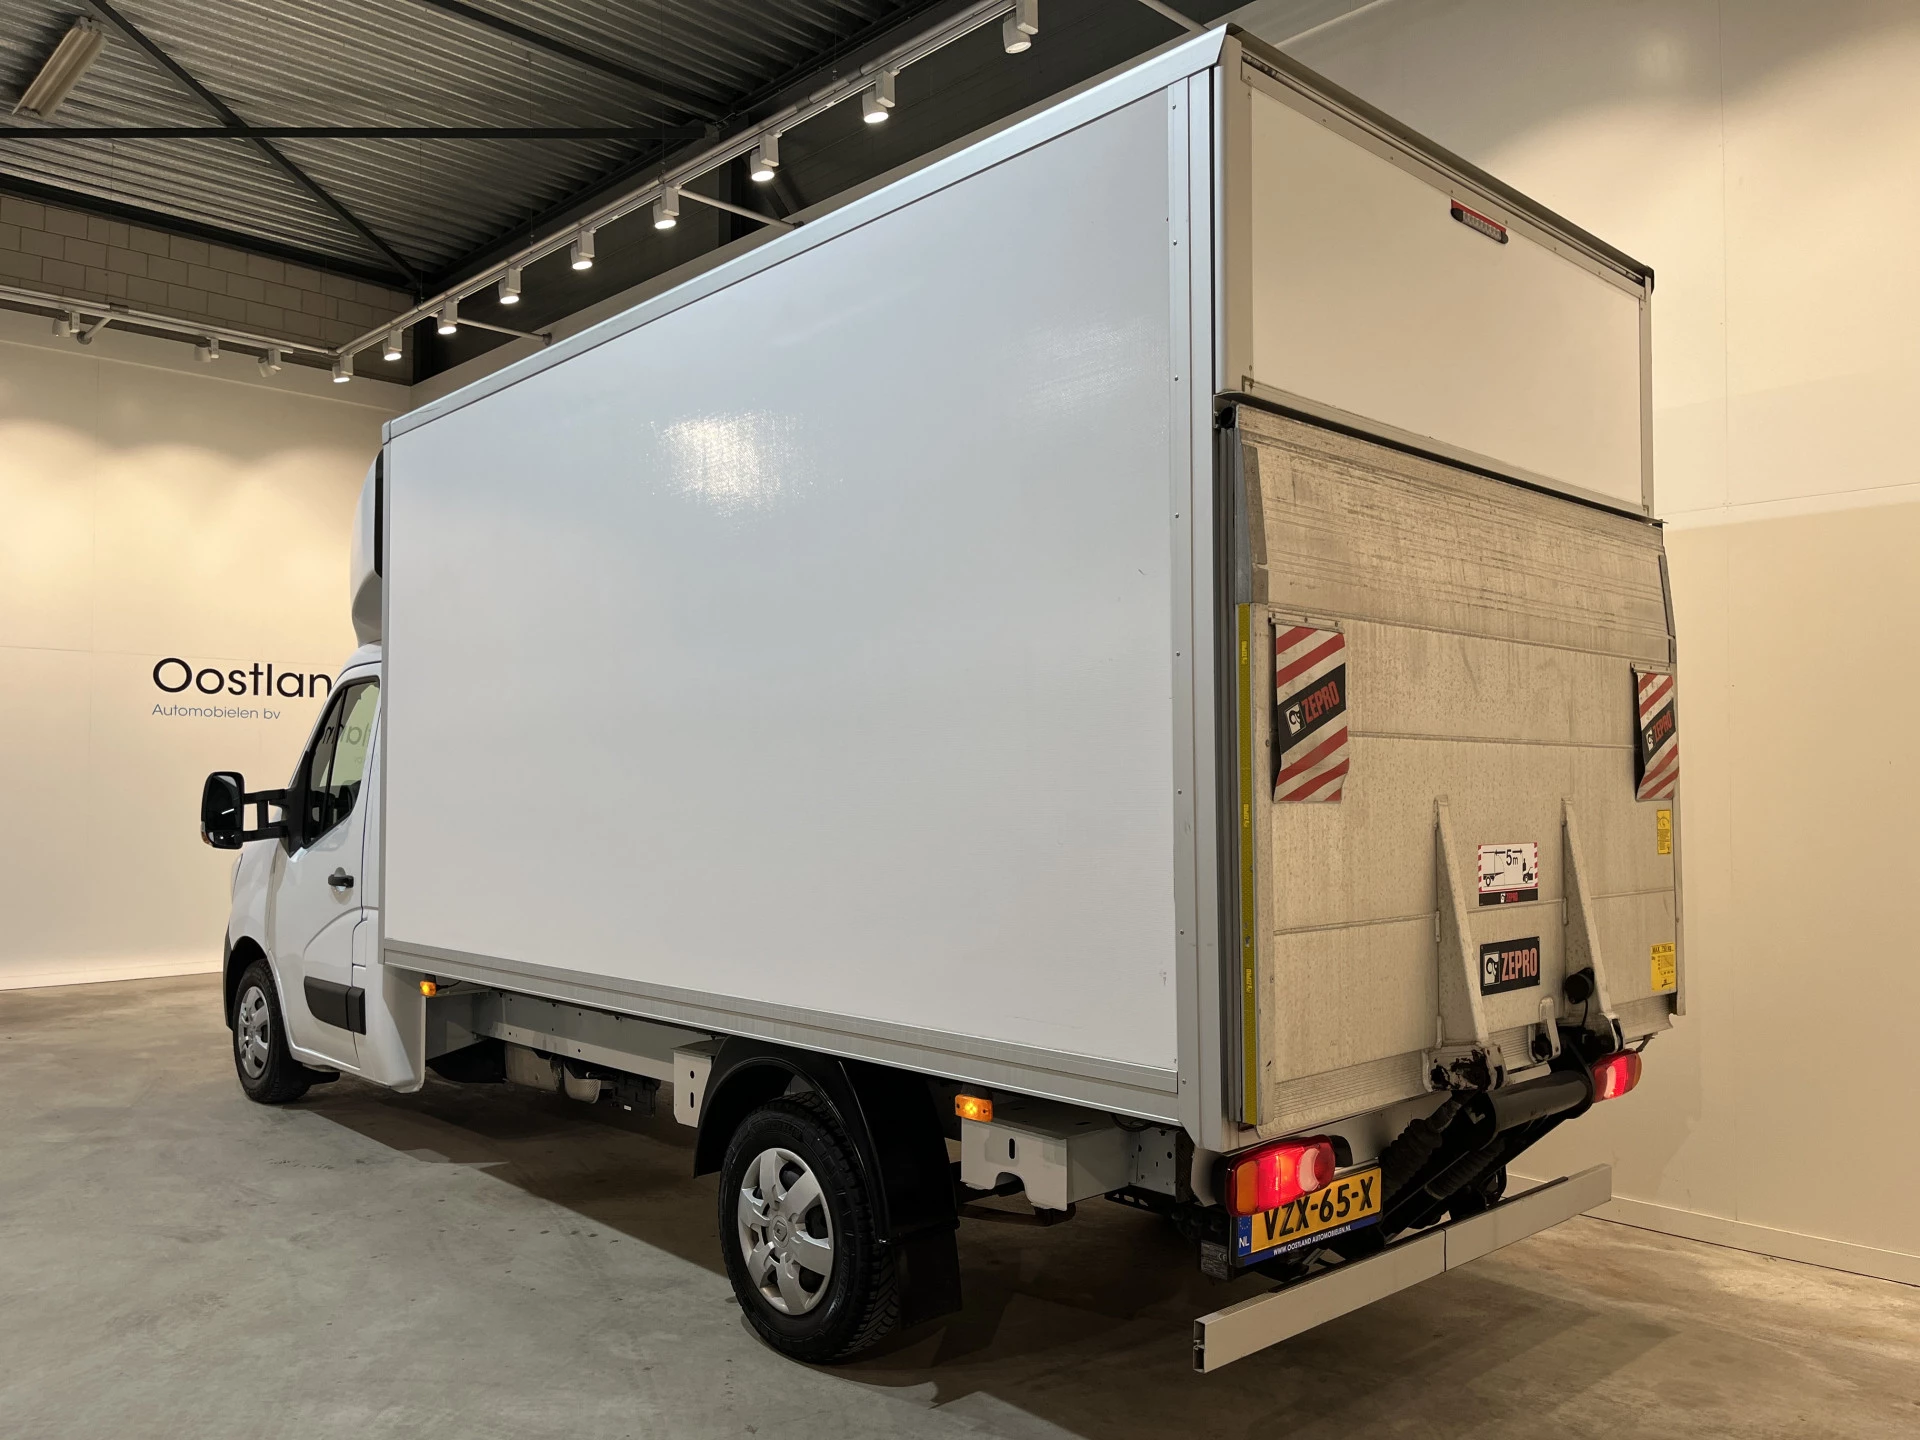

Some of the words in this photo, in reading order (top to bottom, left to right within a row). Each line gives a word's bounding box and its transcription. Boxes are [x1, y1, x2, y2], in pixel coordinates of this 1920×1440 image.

[152, 657, 333, 698] Oostlan
[151, 703, 259, 719] Automobielen
[263, 707, 281, 720] bv
[1301, 681, 1340, 723] ZEPRO
[1653, 711, 1672, 742] ZEPRO
[1501, 948, 1538, 982] ZEPRO
[1263, 1176, 1374, 1241] VZX-65-X
[1238, 1236, 1250, 1248] NL
